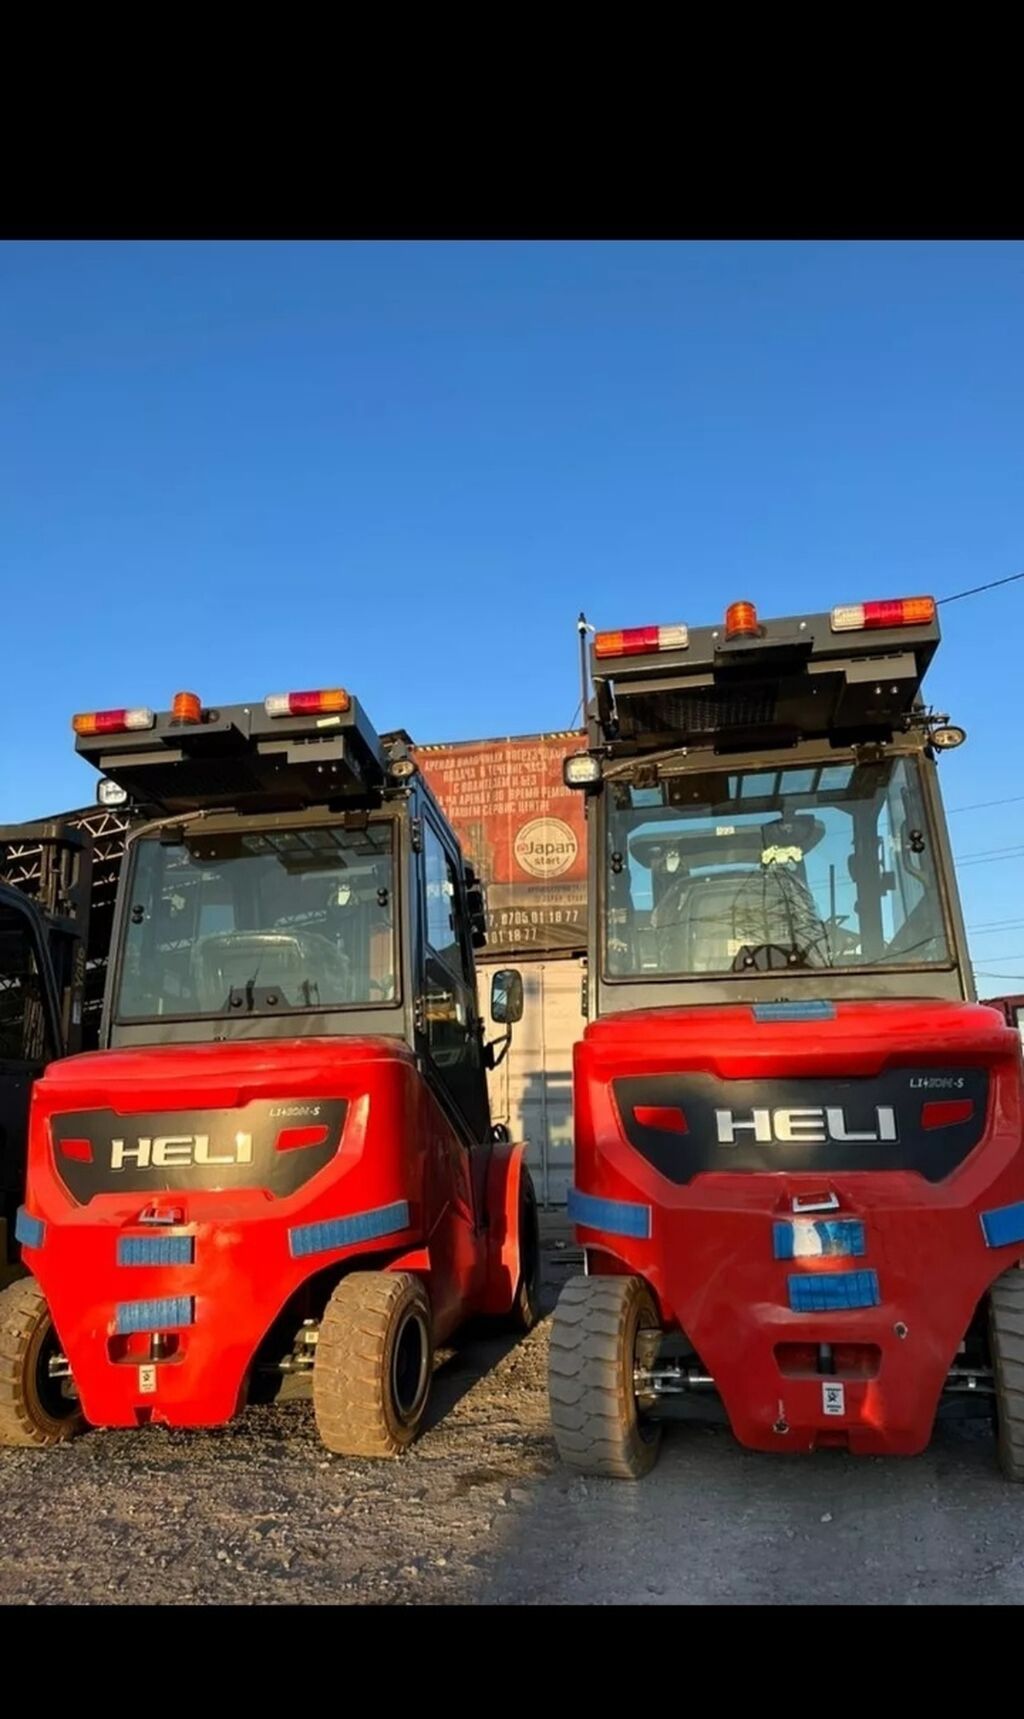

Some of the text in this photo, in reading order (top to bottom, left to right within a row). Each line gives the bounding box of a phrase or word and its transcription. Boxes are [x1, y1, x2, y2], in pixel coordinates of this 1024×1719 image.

[534, 856, 561, 866] start
[565, 909, 579, 922] 77
[714, 1105, 898, 1144] HELI
[110, 1131, 254, 1170] HELI
